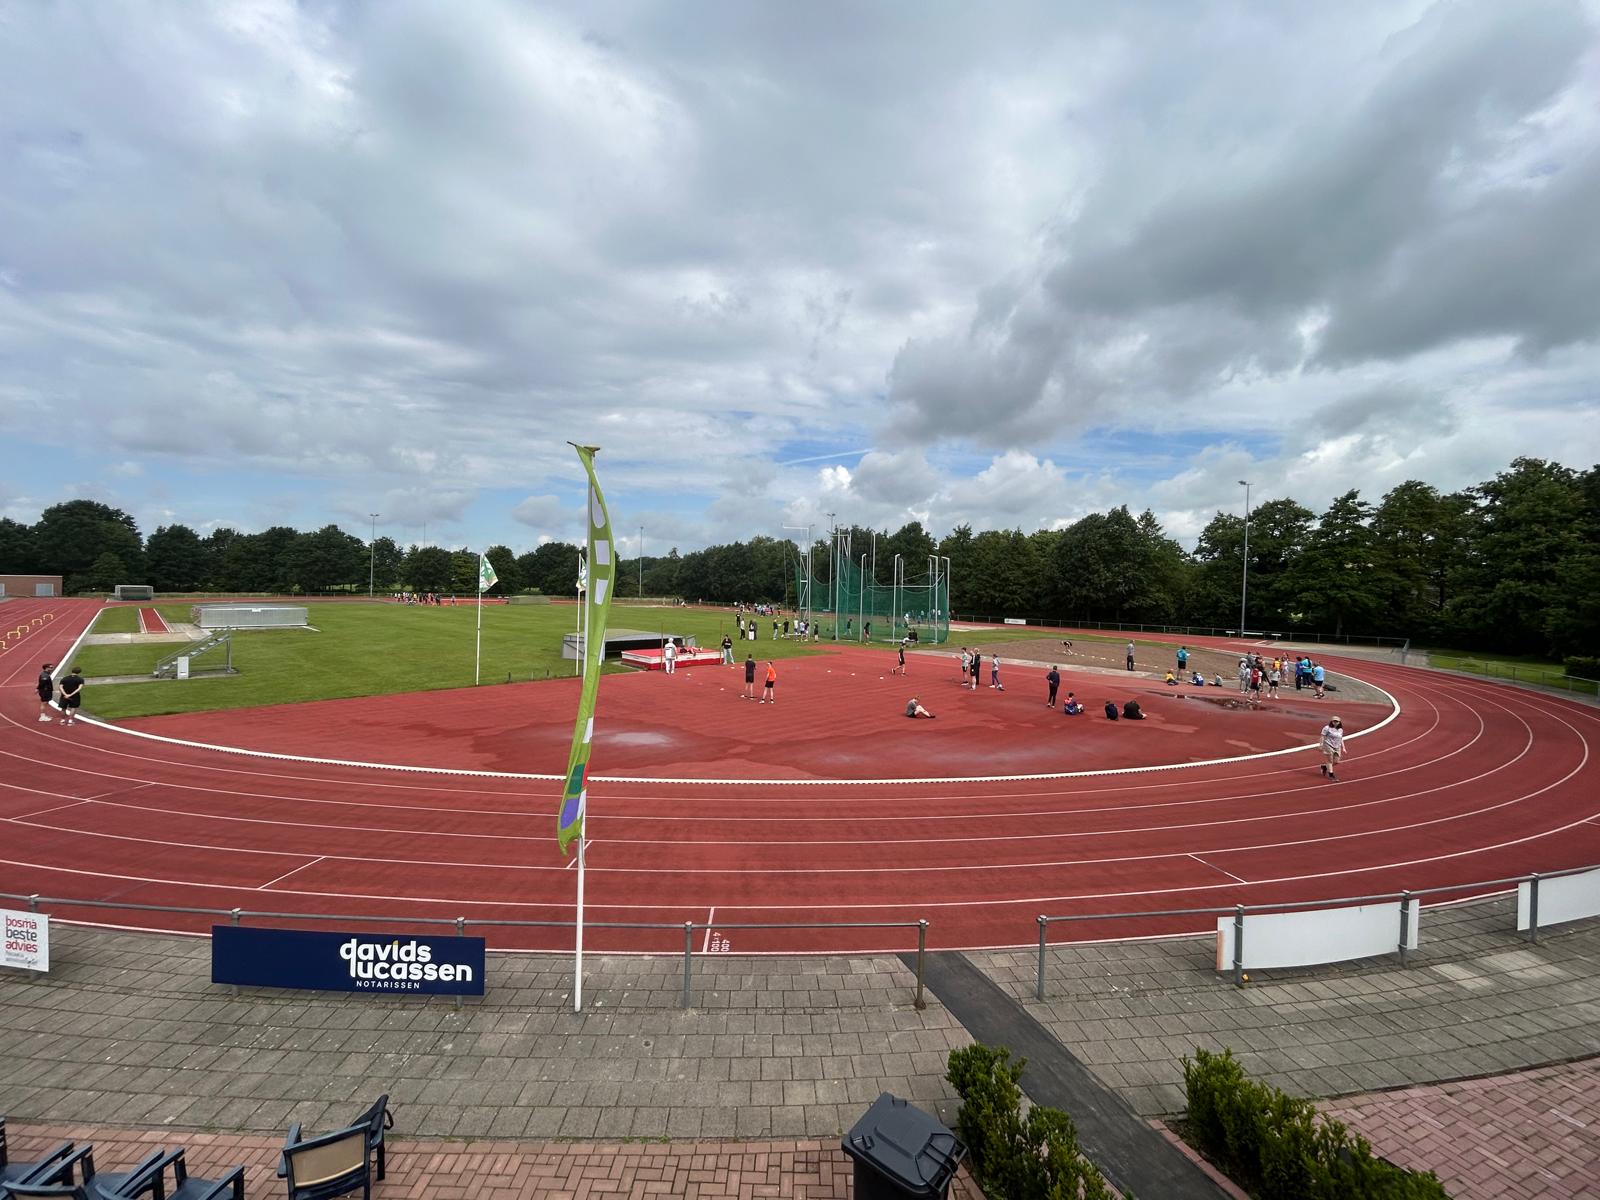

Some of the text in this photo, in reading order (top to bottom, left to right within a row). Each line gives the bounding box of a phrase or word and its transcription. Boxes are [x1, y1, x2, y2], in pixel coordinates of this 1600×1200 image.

[5, 915, 37, 930] bosma
[5, 926, 37, 942] beste
[5, 939, 38, 953] advies
[340, 938, 432, 962] davids
[720, 939, 730, 952] 400
[350, 957, 473, 982] lucassen
[356, 980, 420, 989] NOTARISSEN
